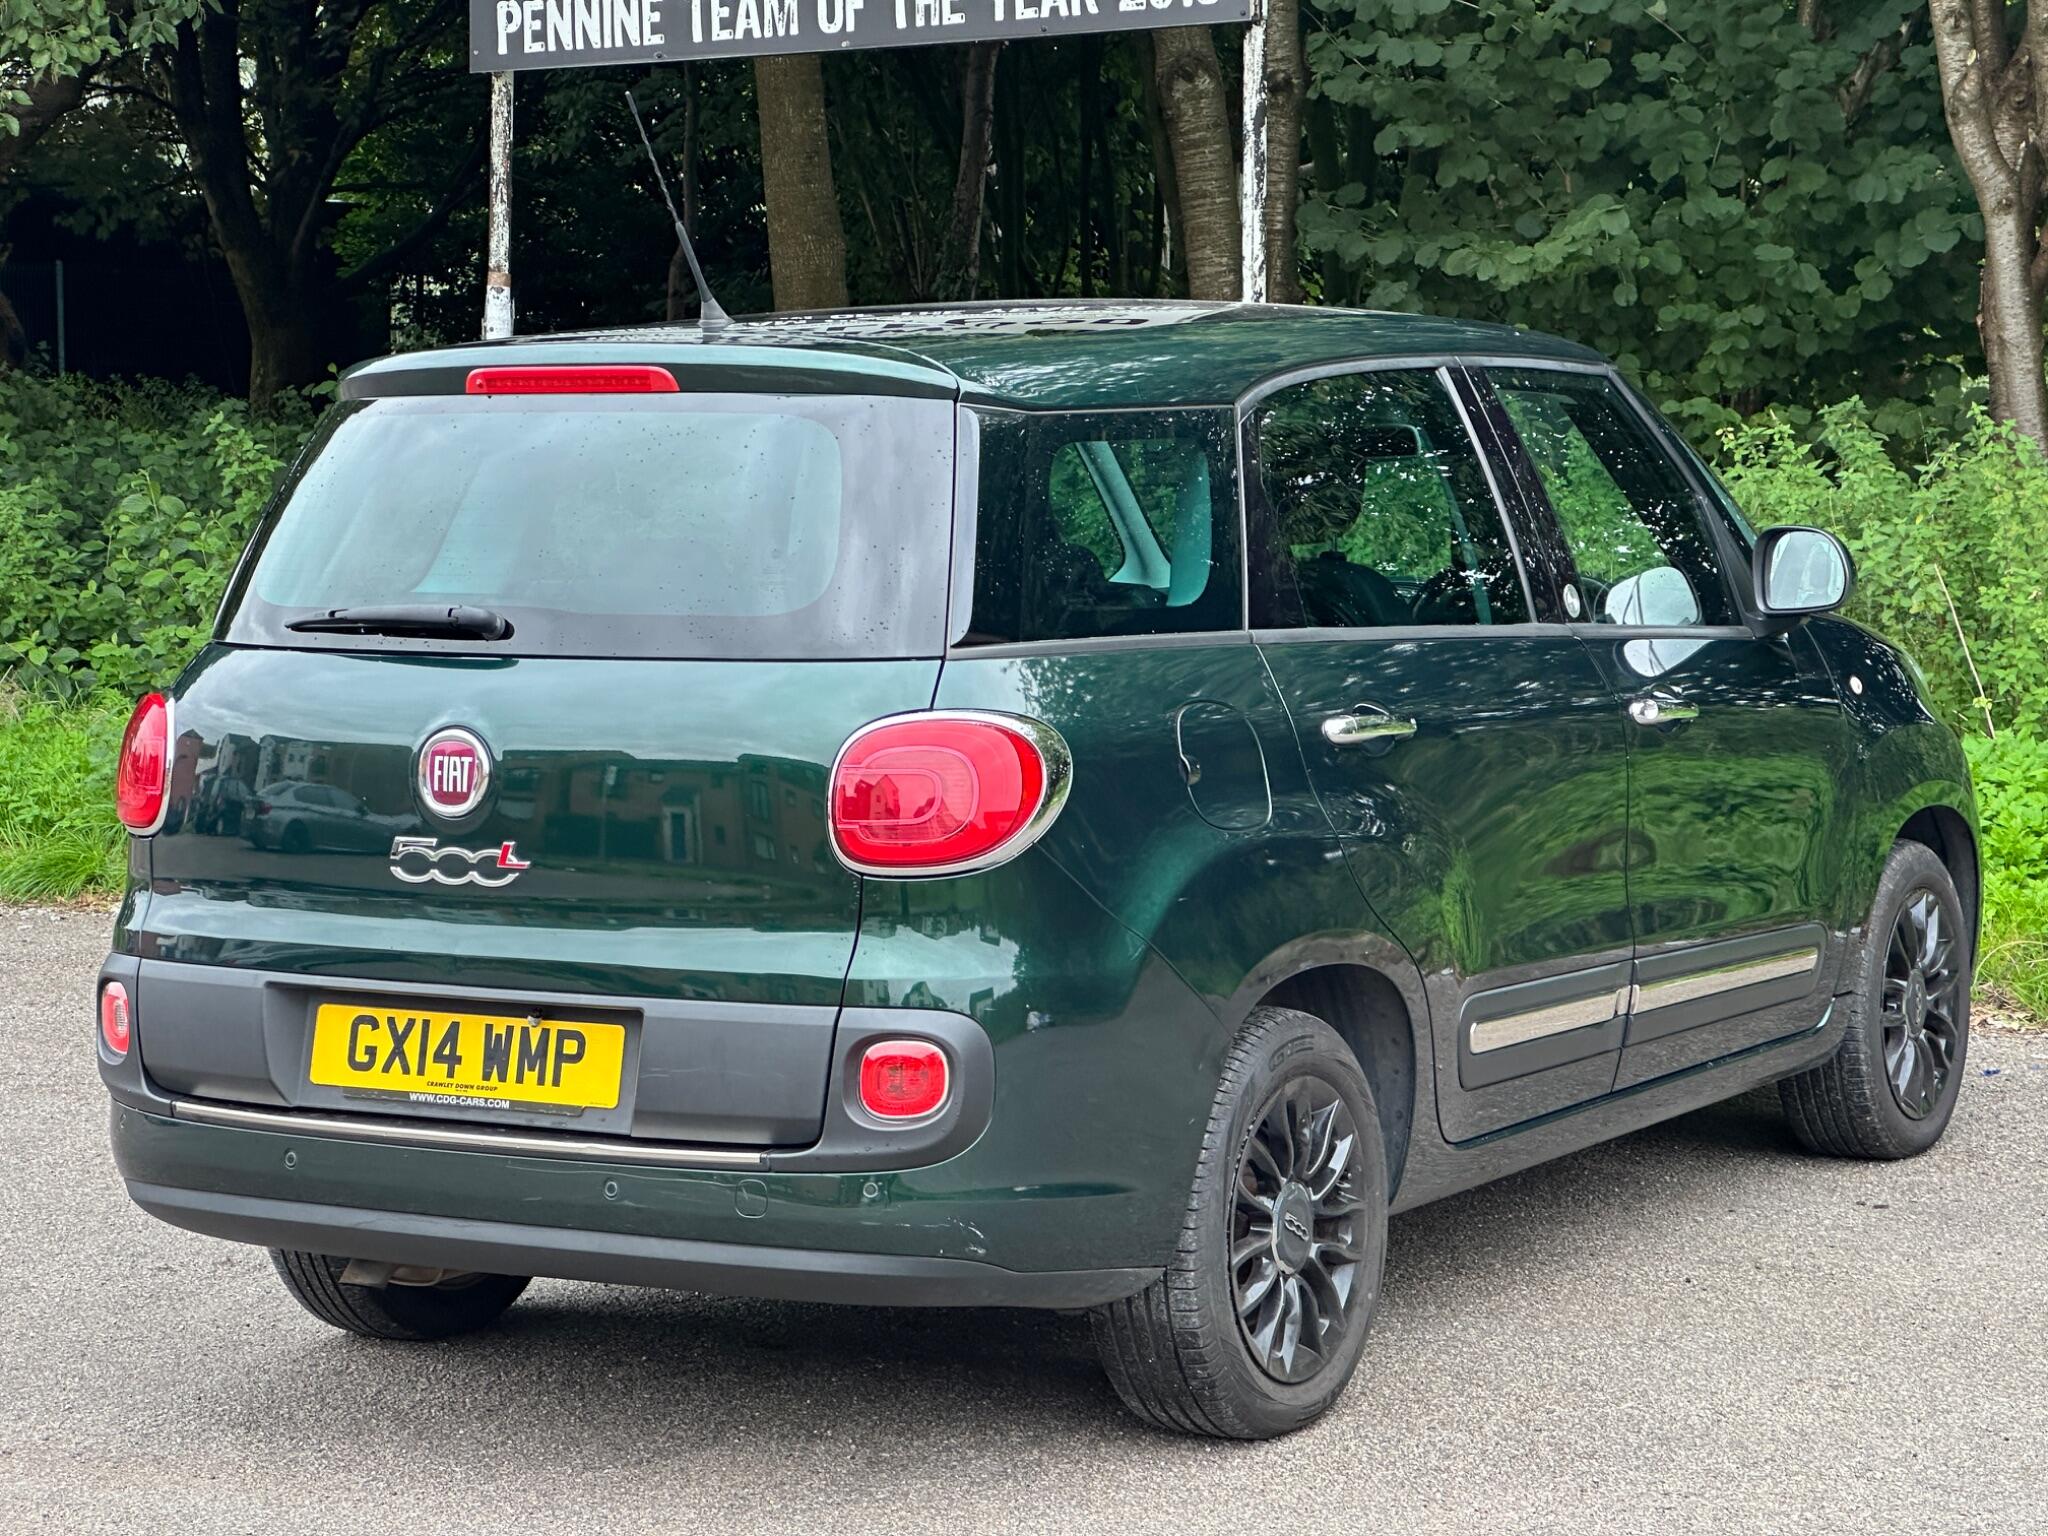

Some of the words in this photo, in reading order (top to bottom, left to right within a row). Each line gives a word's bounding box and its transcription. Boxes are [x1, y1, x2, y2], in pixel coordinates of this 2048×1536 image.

[497, 0, 665, 54] PENNINE
[692, 0, 799, 43] TEAM
[433, 755, 473, 793] FIAT
[390, 836, 531, 888] 500L
[346, 1014, 463, 1080] GX14
[482, 1023, 587, 1088] WMP
[409, 1092, 510, 1109] WWW.CDG-CARS.COM
[426, 1080, 454, 1089] CRAWLEY
